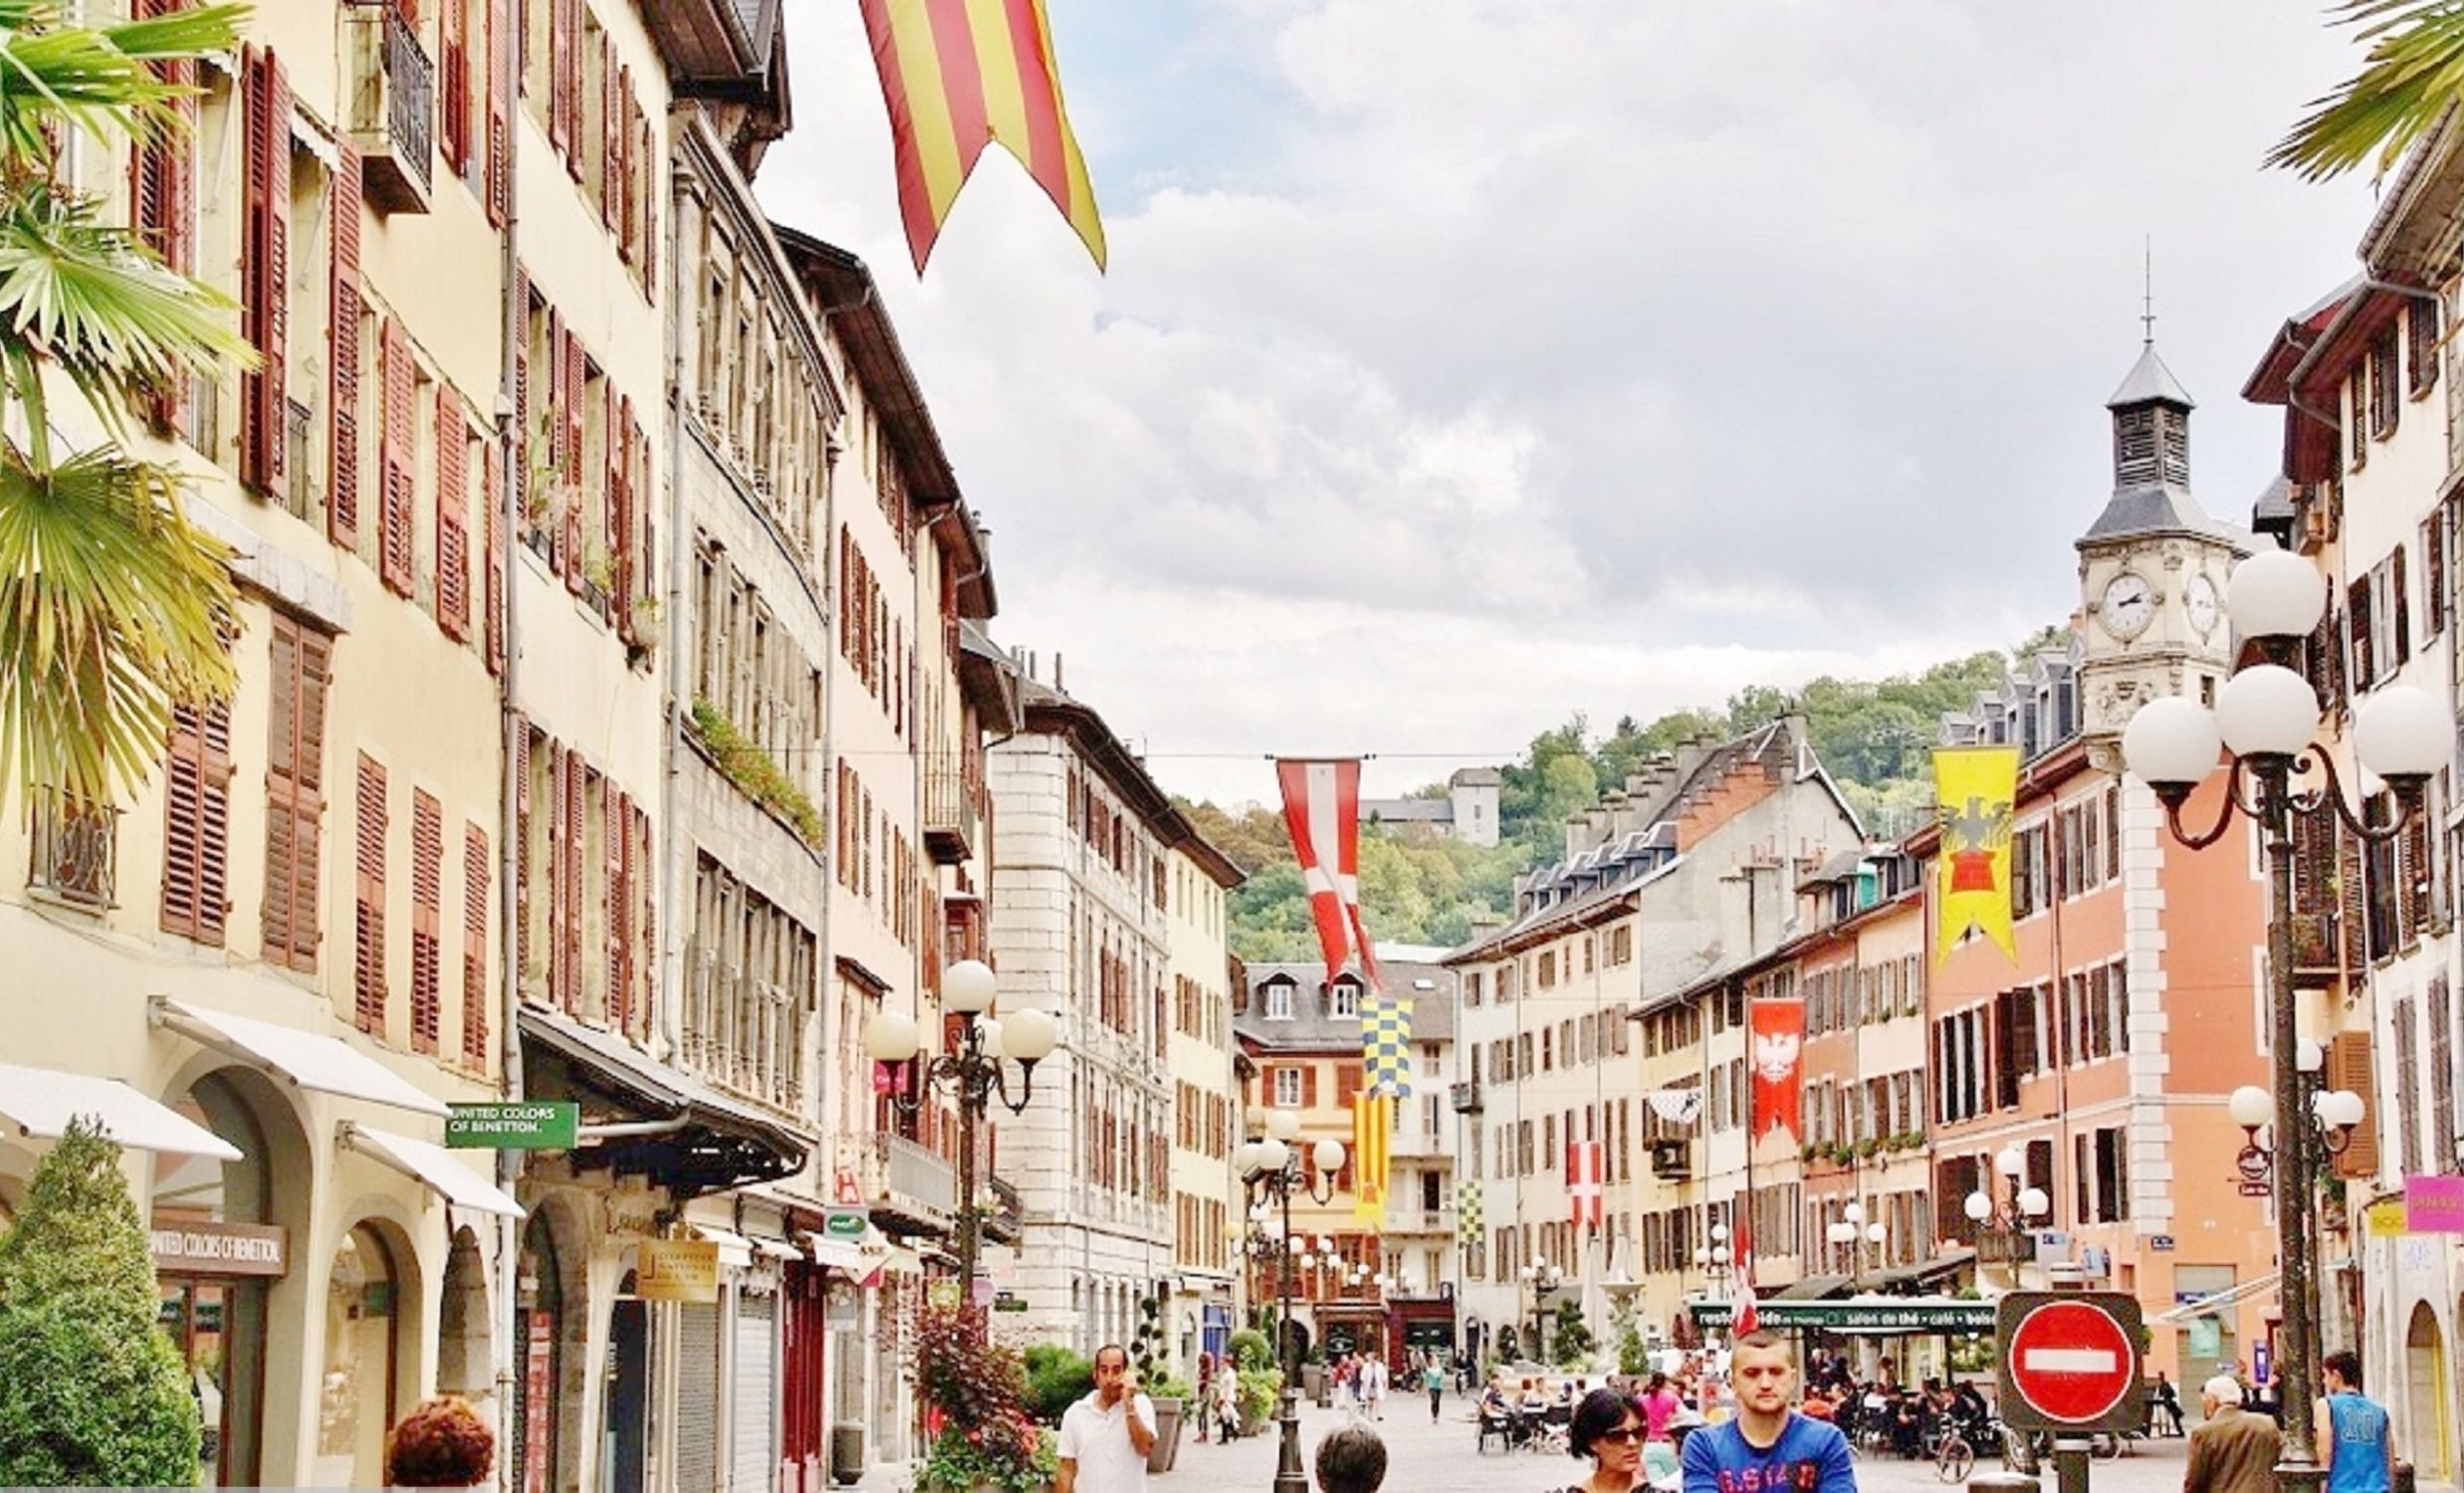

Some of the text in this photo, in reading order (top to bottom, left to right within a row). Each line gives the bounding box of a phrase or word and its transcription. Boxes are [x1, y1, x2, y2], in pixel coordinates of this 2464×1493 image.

[502, 1108, 556, 1120] COLORS
[450, 1121, 468, 1133] OF
[1847, 1312, 1879, 1325] salon
[1882, 1312, 1898, 1325] de
[1899, 1311, 1919, 1325] thé
